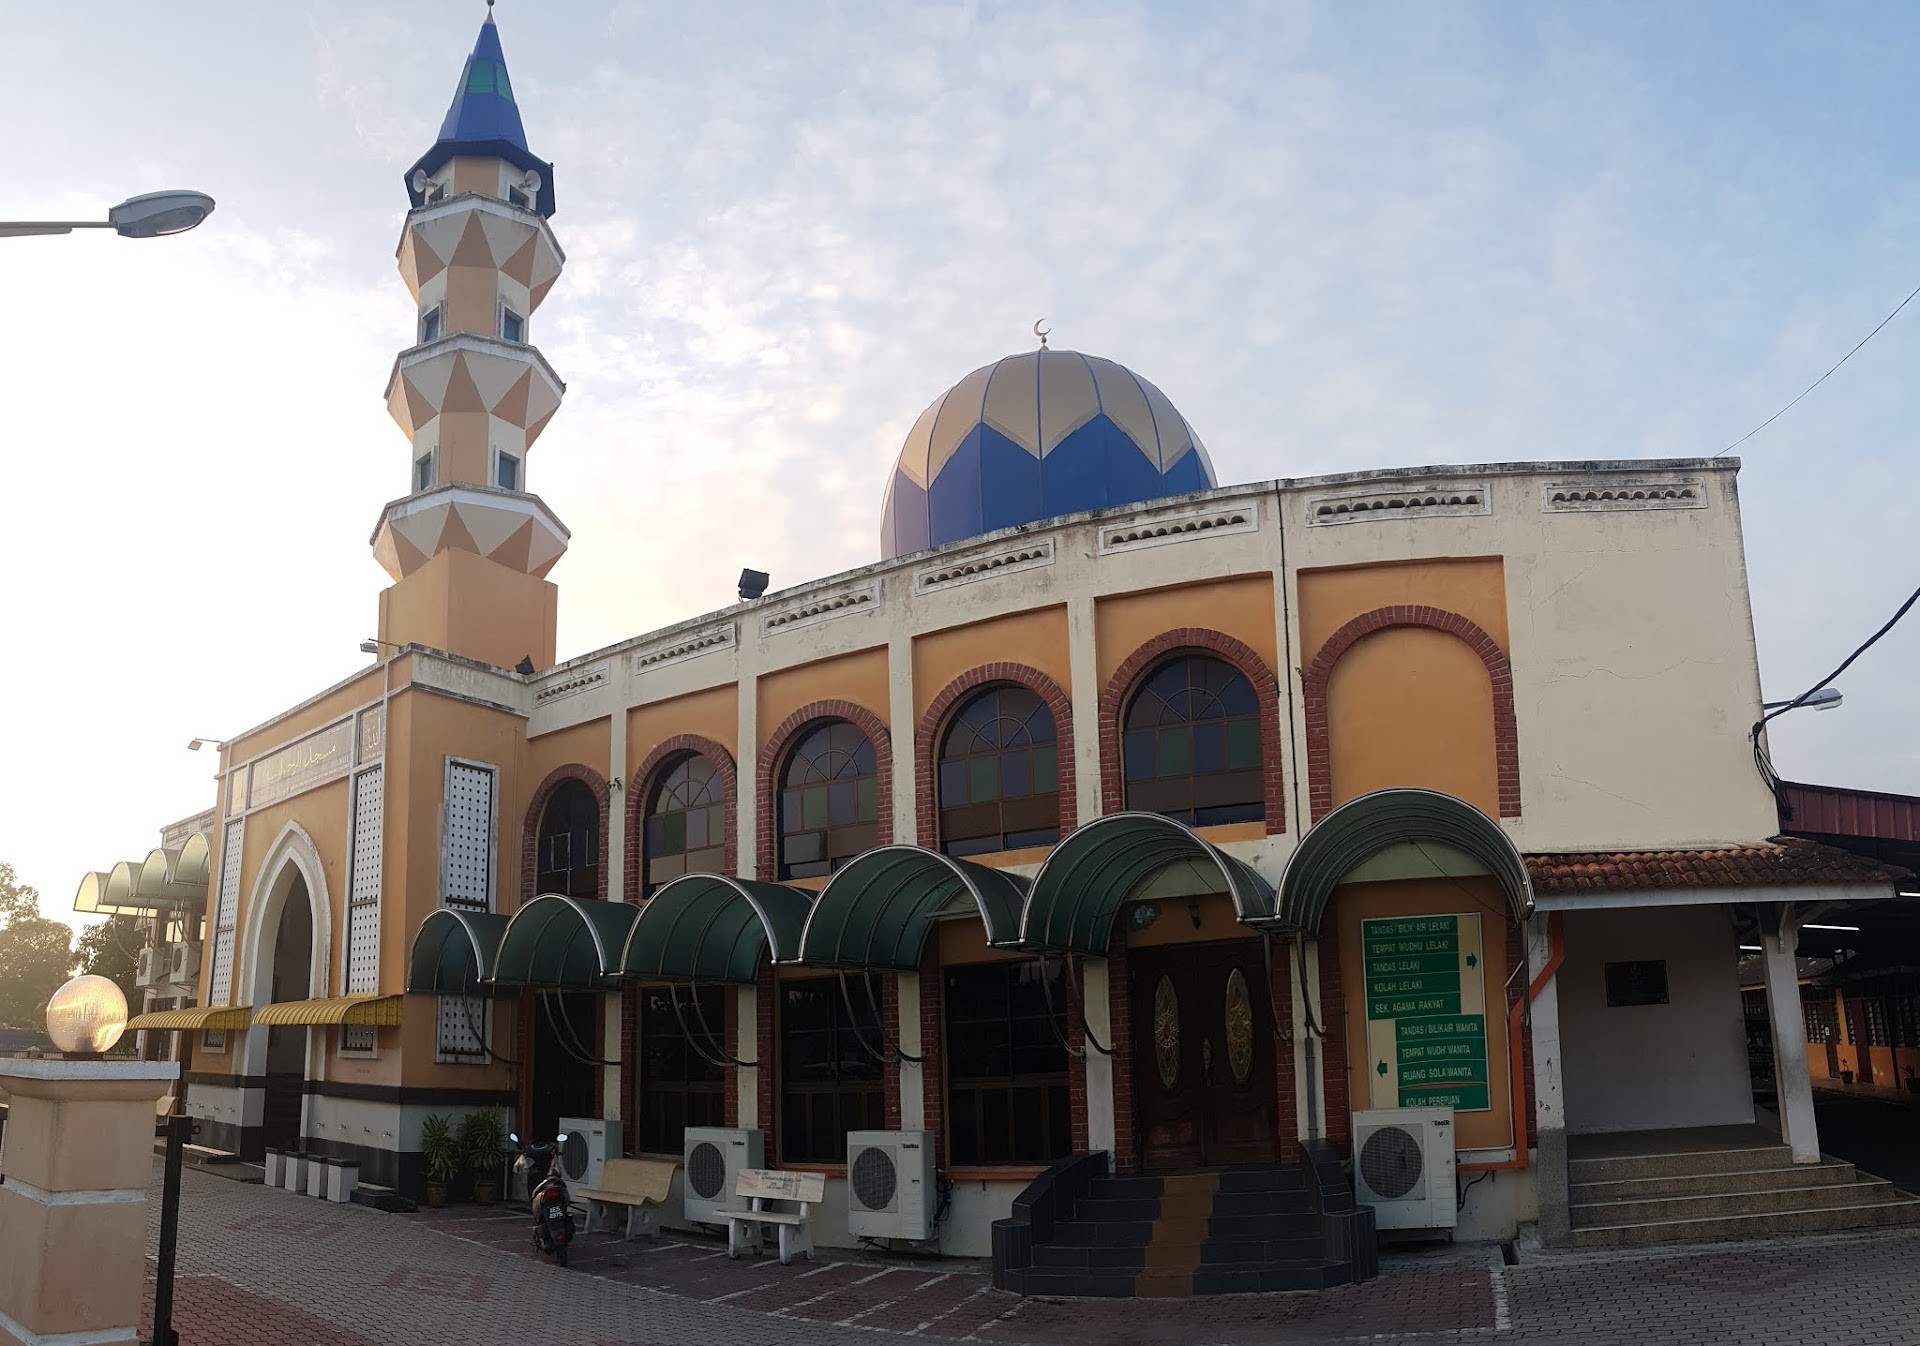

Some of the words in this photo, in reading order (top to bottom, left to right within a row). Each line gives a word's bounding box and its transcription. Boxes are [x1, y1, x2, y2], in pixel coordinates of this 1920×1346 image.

[1428, 920, 1449, 931] LELAKI
[1372, 943, 1396, 954] TEMPAT
[1426, 939, 1448, 950] LELAKI
[1373, 962, 1396, 972] TANDAS
[1399, 960, 1420, 971] LELAKI
[1374, 982, 1396, 992] KOLAH
[1399, 980, 1423, 991] LELAKI
[1375, 1004, 1390, 1013] SEK.
[1393, 1002, 1416, 1011] AGAMA
[1419, 1000, 1443, 1010] RAKYAT
[1456, 1022, 1478, 1032] WANITA
[1402, 1047, 1424, 1058] TEMPAT
[1403, 1070, 1426, 1081] RUANG
[1448, 1066, 1472, 1077] WANITA
